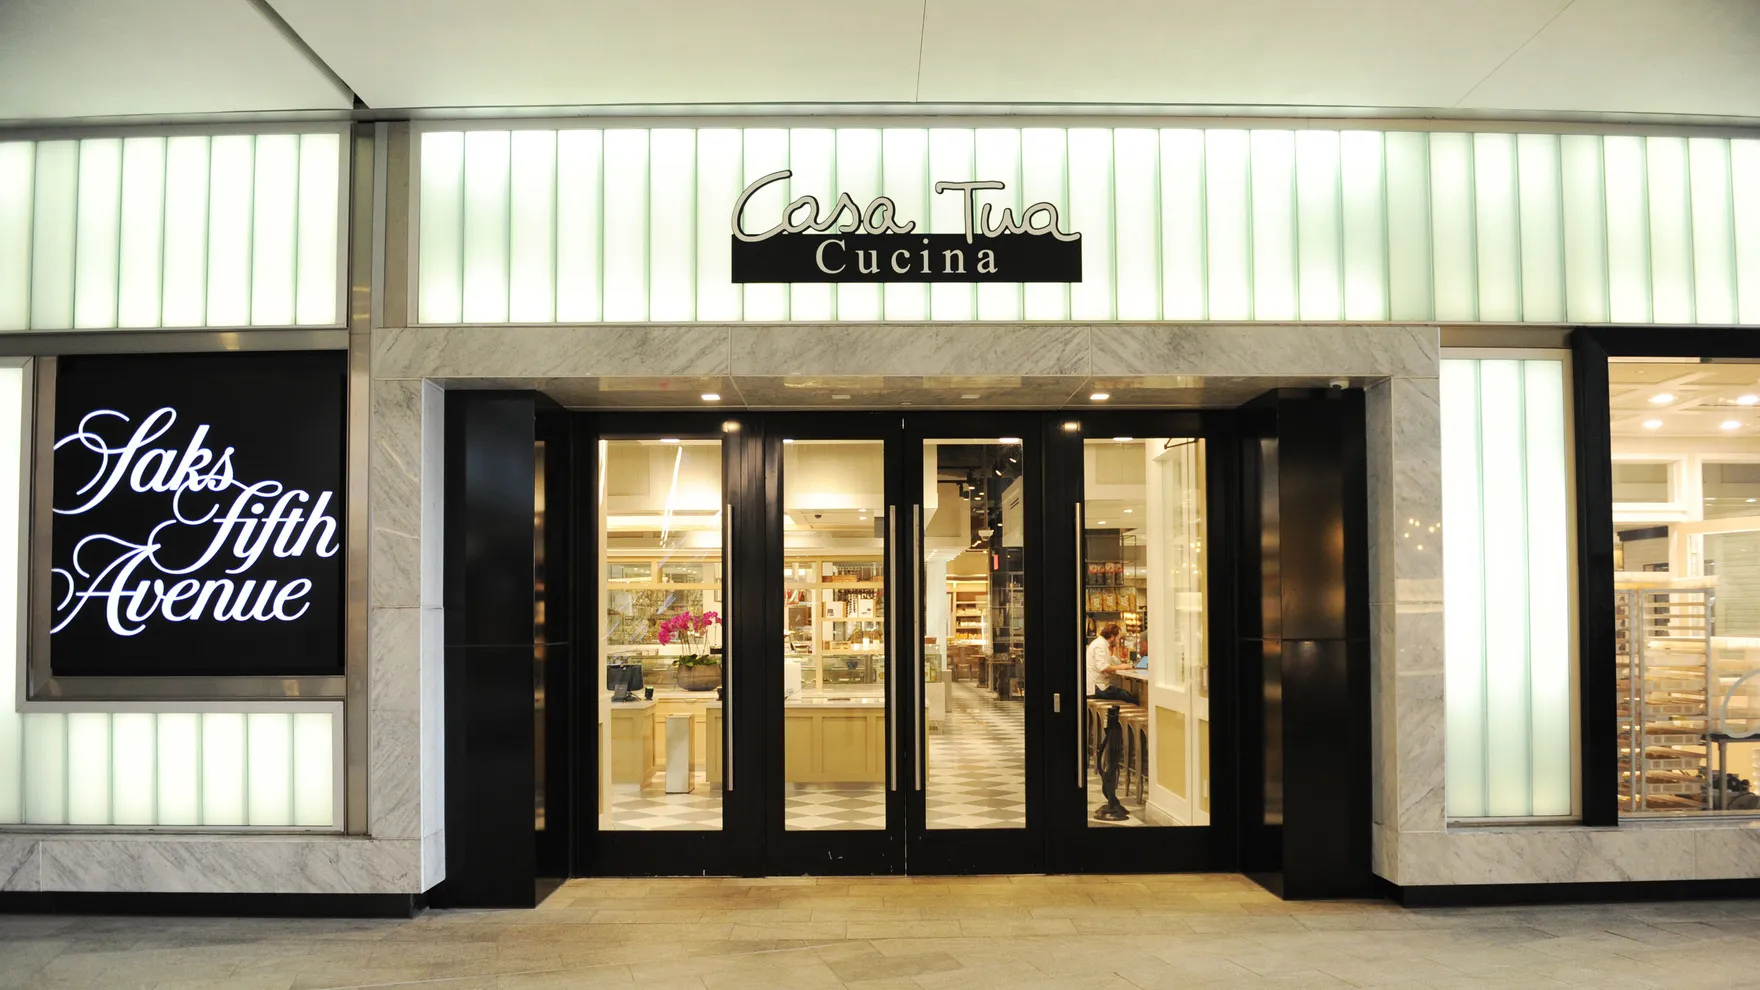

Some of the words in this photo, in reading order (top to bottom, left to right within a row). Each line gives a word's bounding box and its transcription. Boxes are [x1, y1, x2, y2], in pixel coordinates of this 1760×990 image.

[731, 169, 916, 243] Casa
[935, 181, 1081, 244] Tua
[815, 237, 999, 275] Cucina
[52, 406, 235, 515] Saks
[50, 533, 313, 636] Avenue
